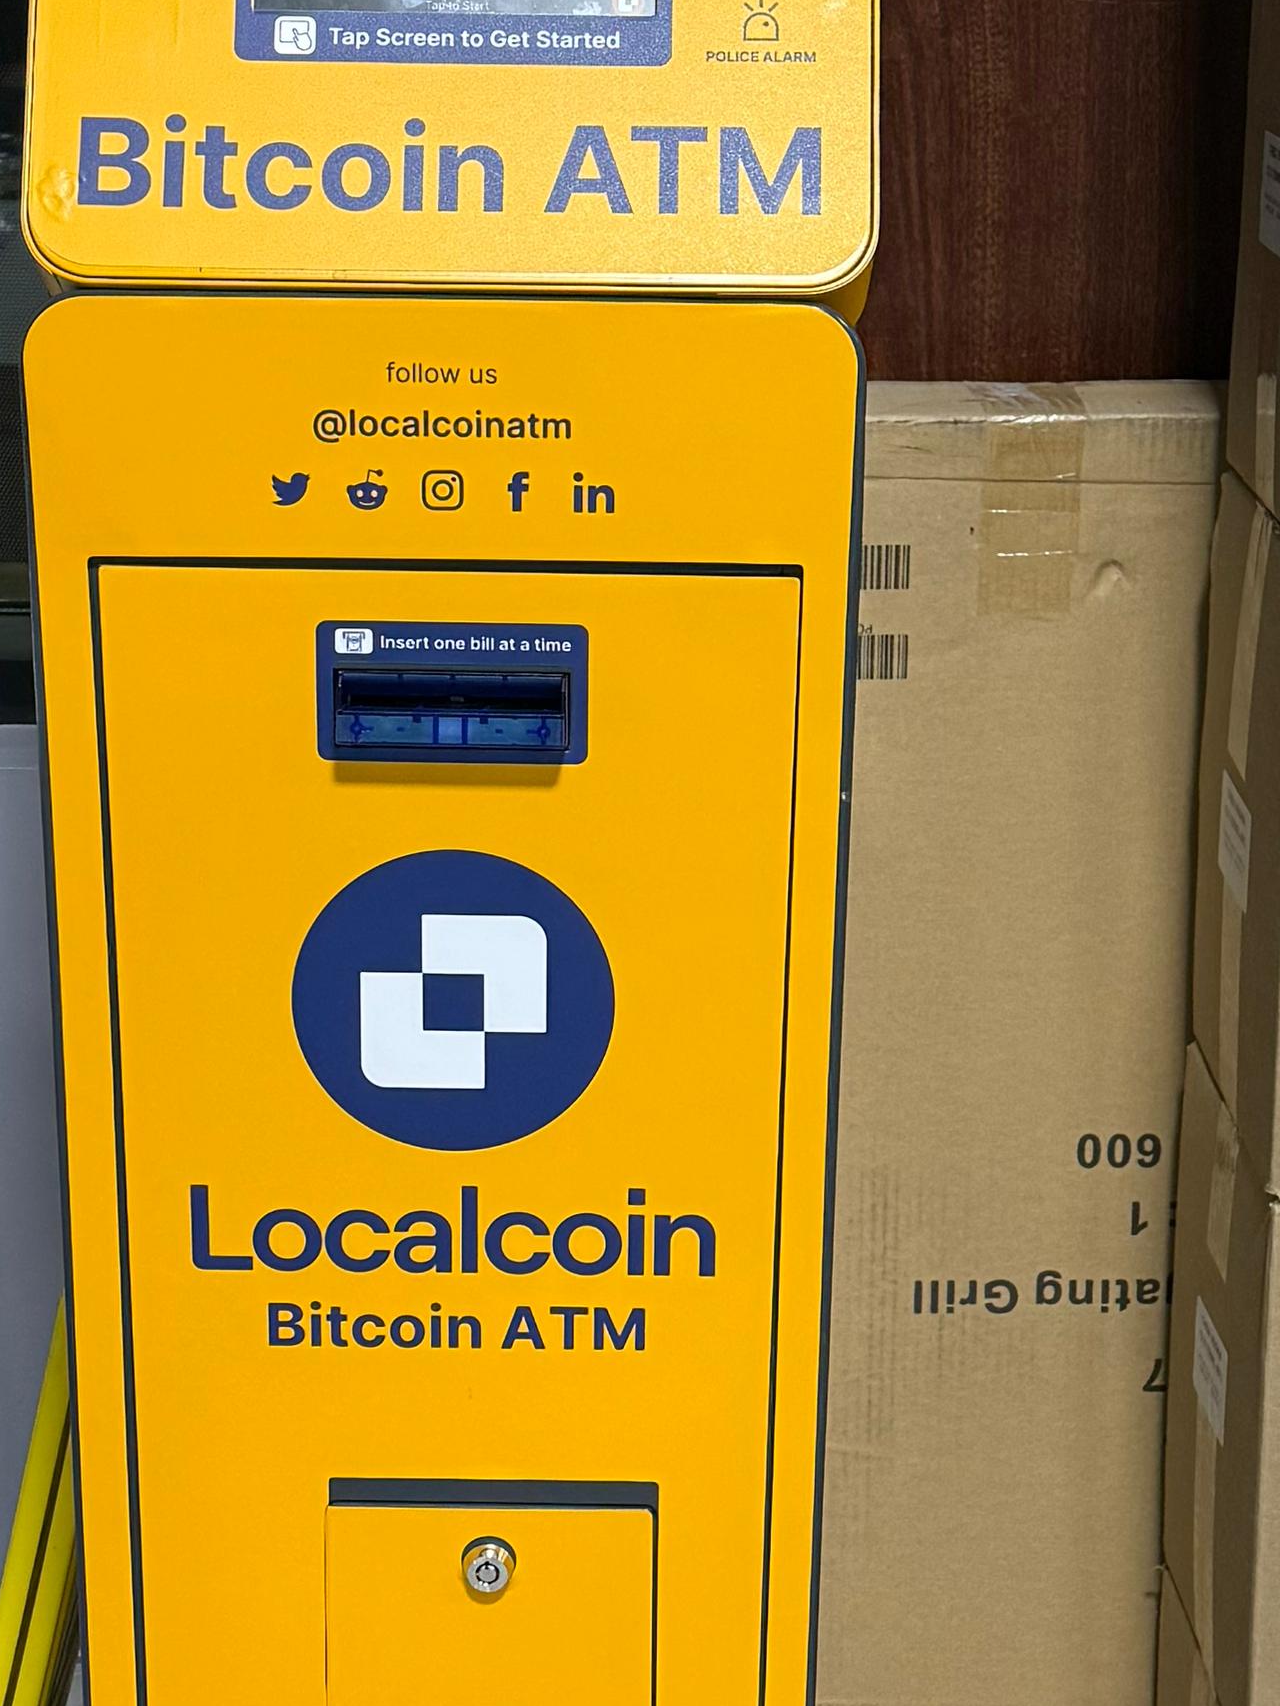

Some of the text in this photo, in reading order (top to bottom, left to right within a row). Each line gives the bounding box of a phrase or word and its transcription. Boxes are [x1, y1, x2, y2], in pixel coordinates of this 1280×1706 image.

[329, 27, 620, 50] Tap Screen to Get Started
[706, 51, 816, 62] POLICE ALARM
[76, 113, 822, 216] Bitcoin ATM
[385, 361, 498, 385] follow us
[312, 408, 573, 443] @localcoinatm
[380, 635, 572, 652] Insert one bill at a time
[1076, 1133, 1162, 1169] 600
[189, 1184, 717, 1278] Localcoin
[1129, 1201, 1149, 1236] 1
[913, 1279, 1019, 1315] Grill
[266, 1300, 647, 1352] Bitcoin ATM
